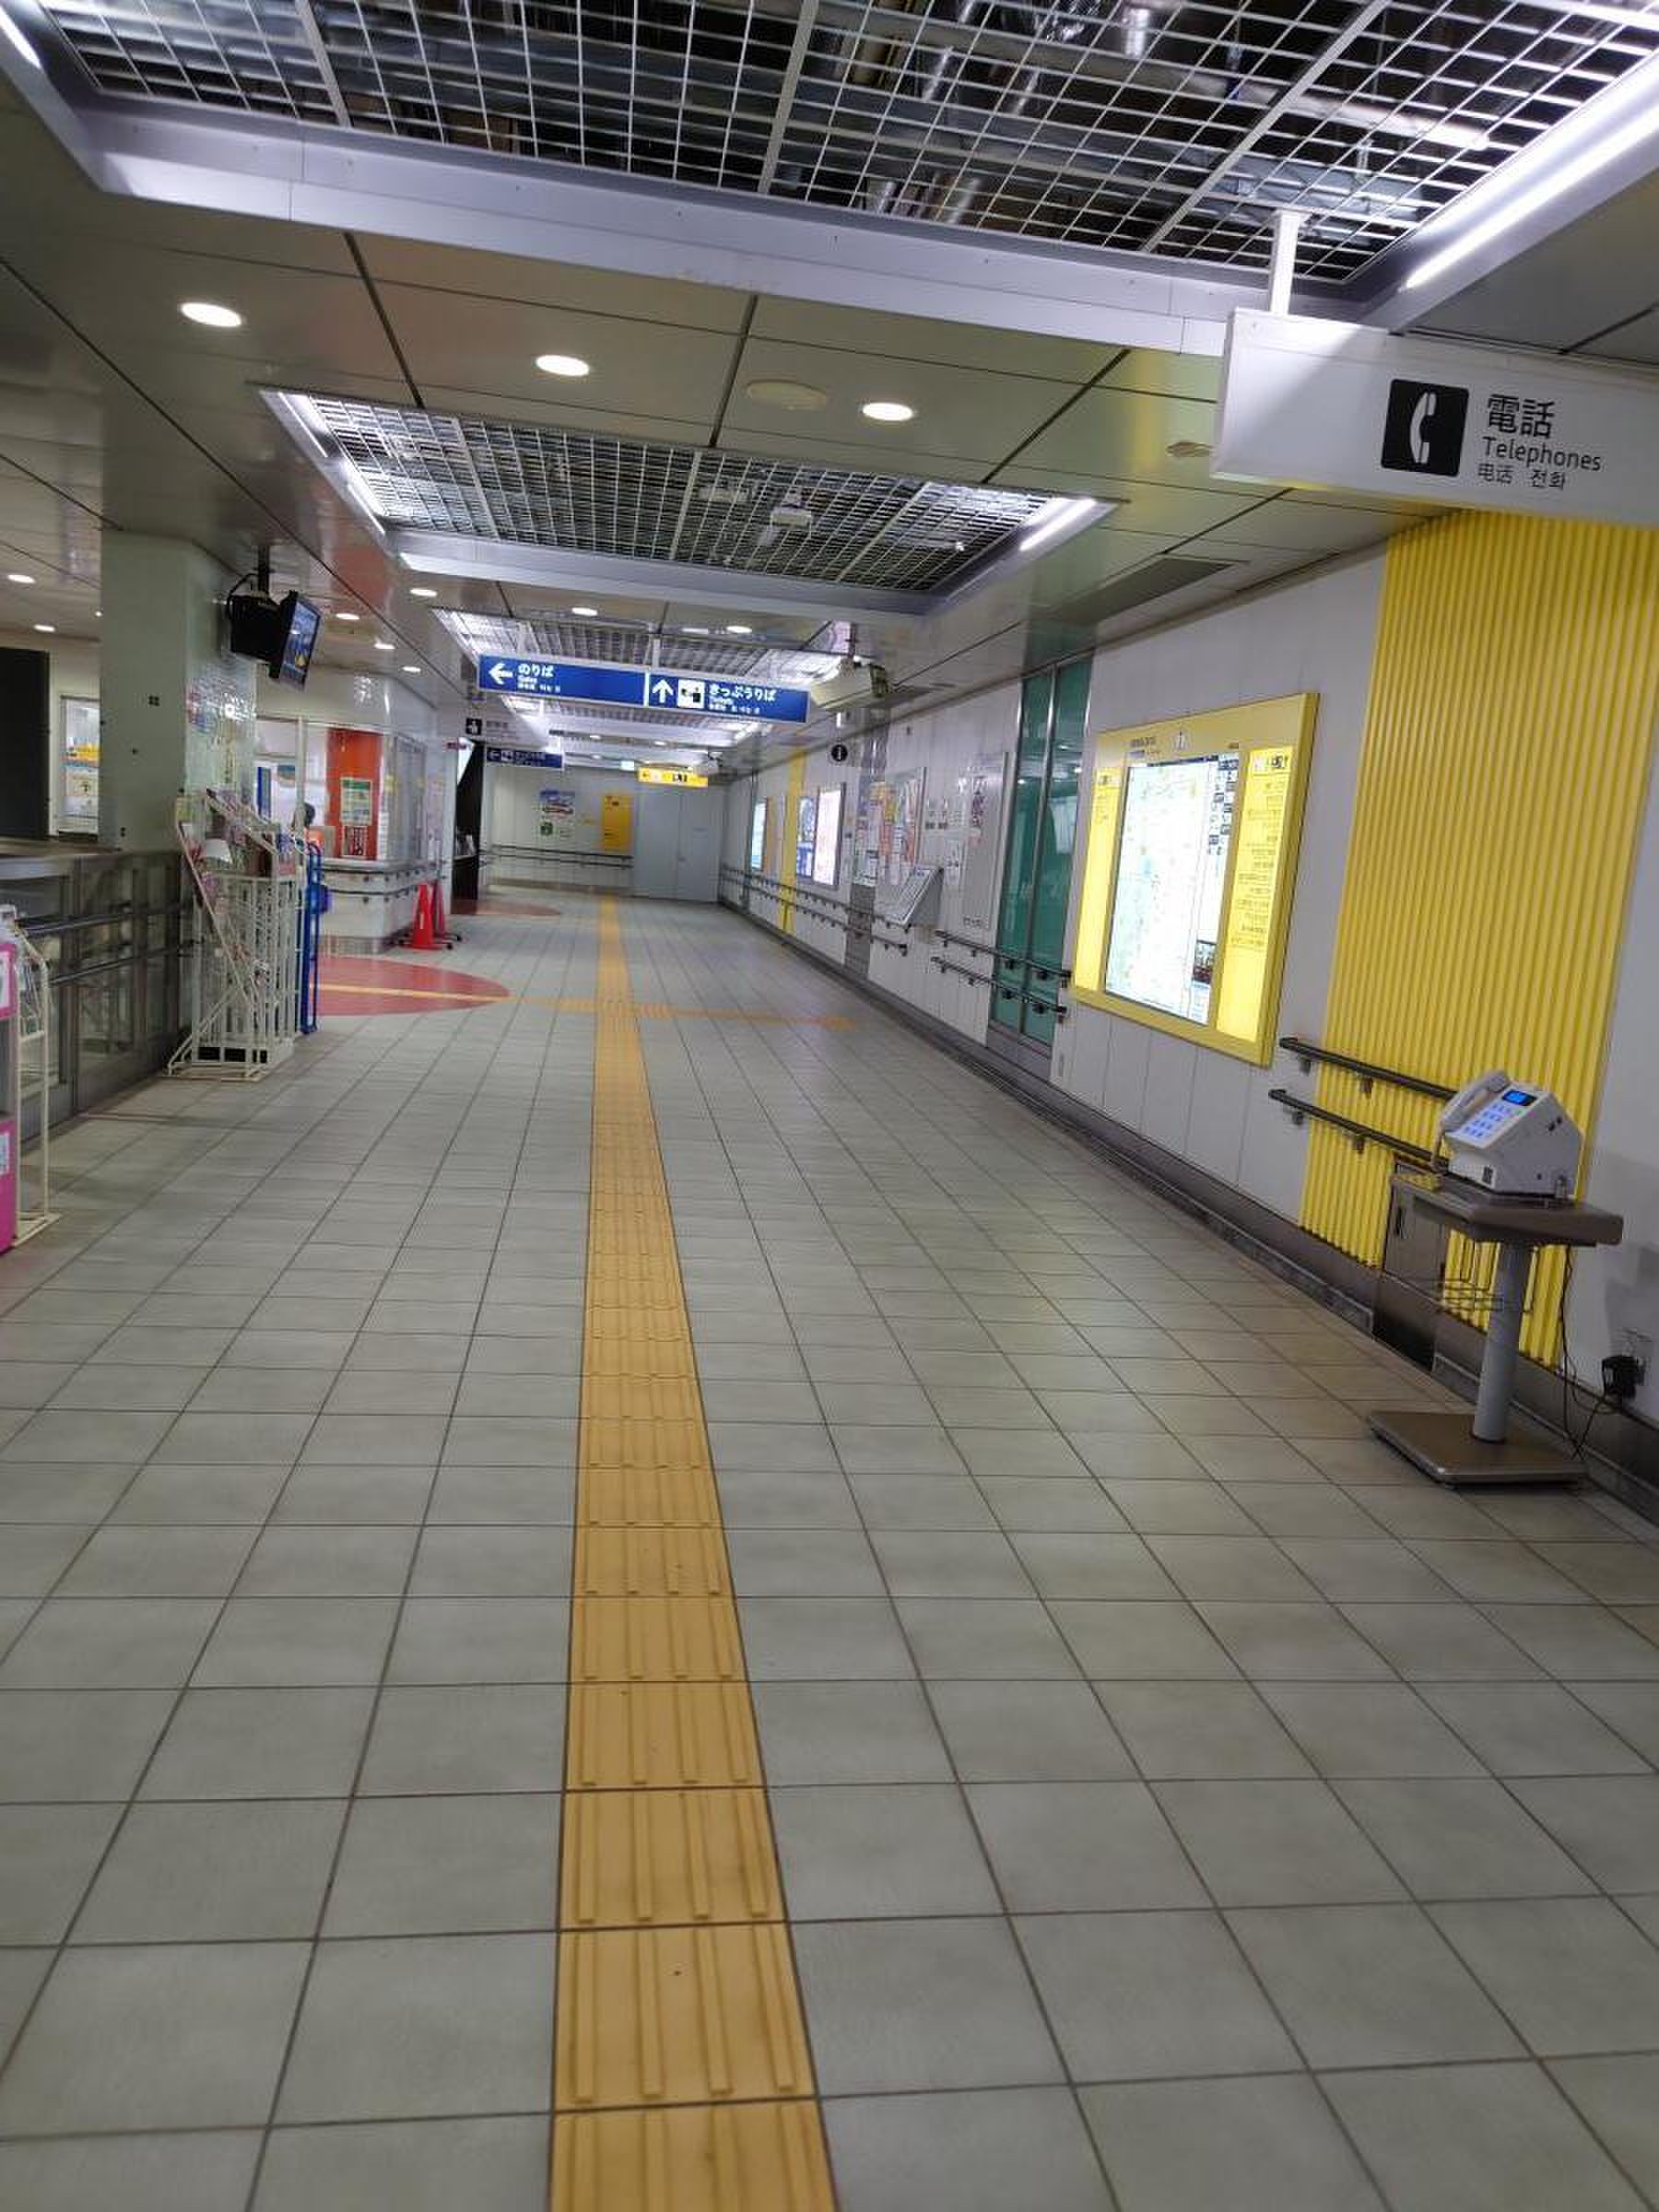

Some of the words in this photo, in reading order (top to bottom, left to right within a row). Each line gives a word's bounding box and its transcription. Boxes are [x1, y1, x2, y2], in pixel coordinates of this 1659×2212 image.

[1488, 394, 1555, 439] 電話
[1482, 436, 1602, 471] Telephones
[1477, 463, 1514, 485] 电话
[517, 663, 554, 678] のりば
[709, 683, 777, 702] きっぷうりば
